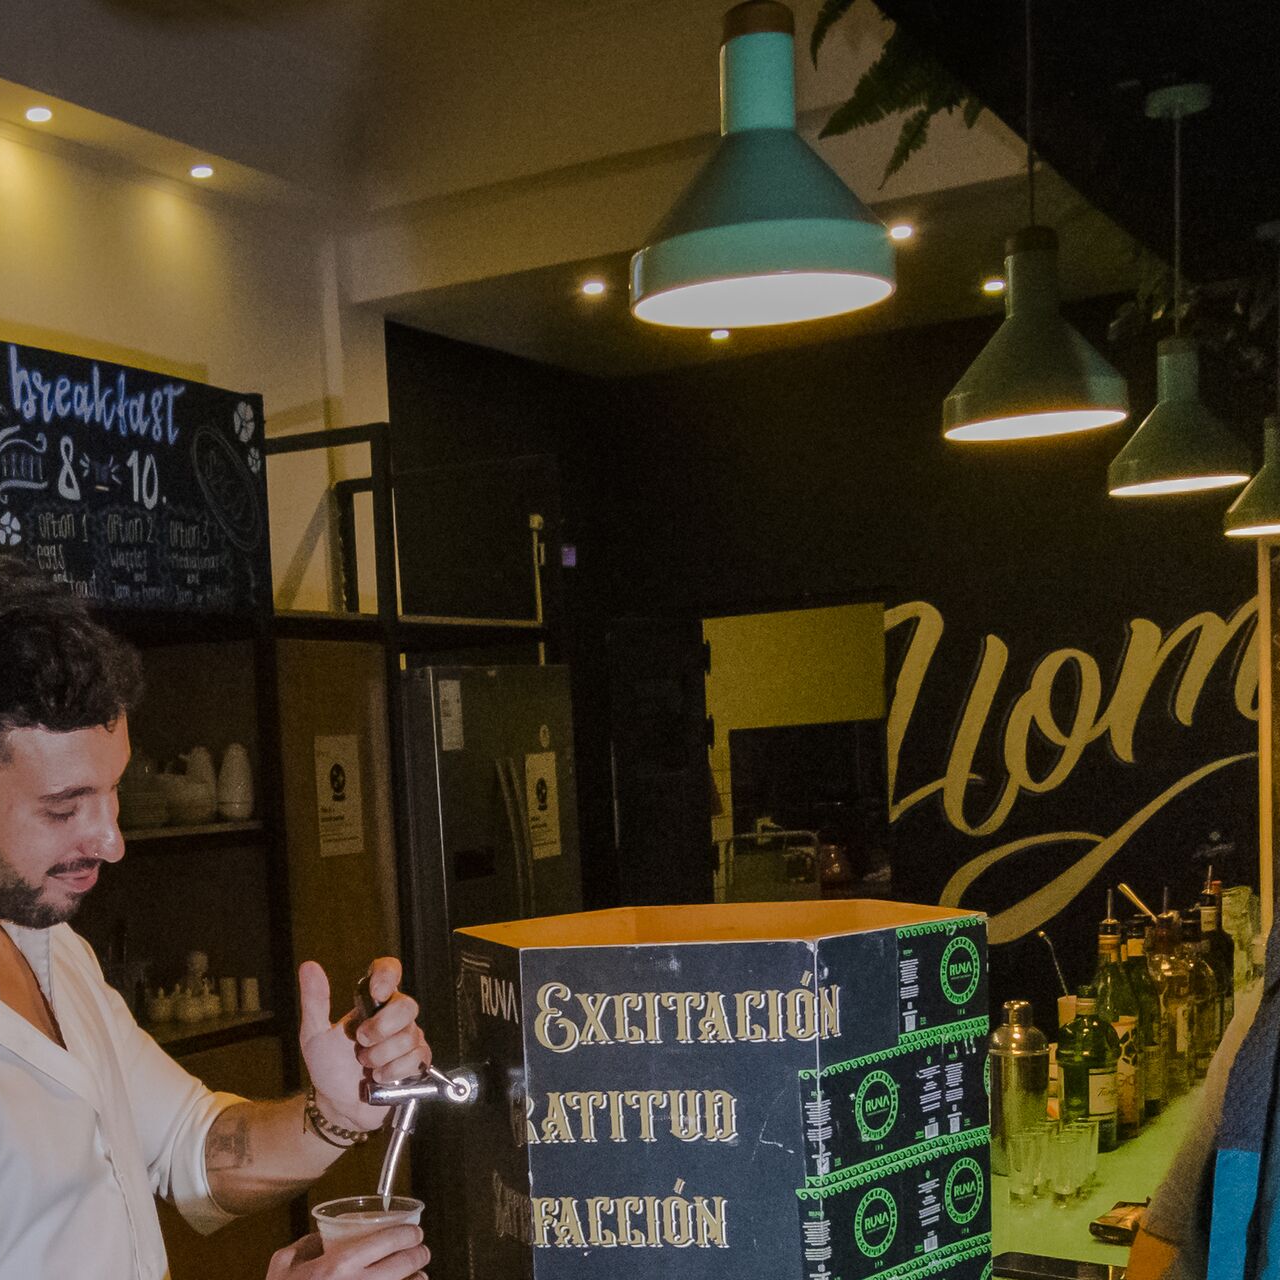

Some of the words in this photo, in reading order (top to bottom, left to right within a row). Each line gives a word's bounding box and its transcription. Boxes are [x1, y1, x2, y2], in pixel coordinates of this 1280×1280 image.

[8, 344, 187, 447] breakfast
[57, 434, 82, 501] 8
[145, 515, 155, 544] 2
[201, 519, 211, 549] 3
[949, 960, 973, 977] RUNA
[479, 974, 519, 1024] RUNA
[533, 969, 843, 1054] EXCITACIÓN
[864, 1094, 891, 1114] RUNA
[951, 1179, 977, 1200] RUNA
[494, 1175, 731, 1250] FACCIÓN
[864, 1210, 891, 1231] RUNA
